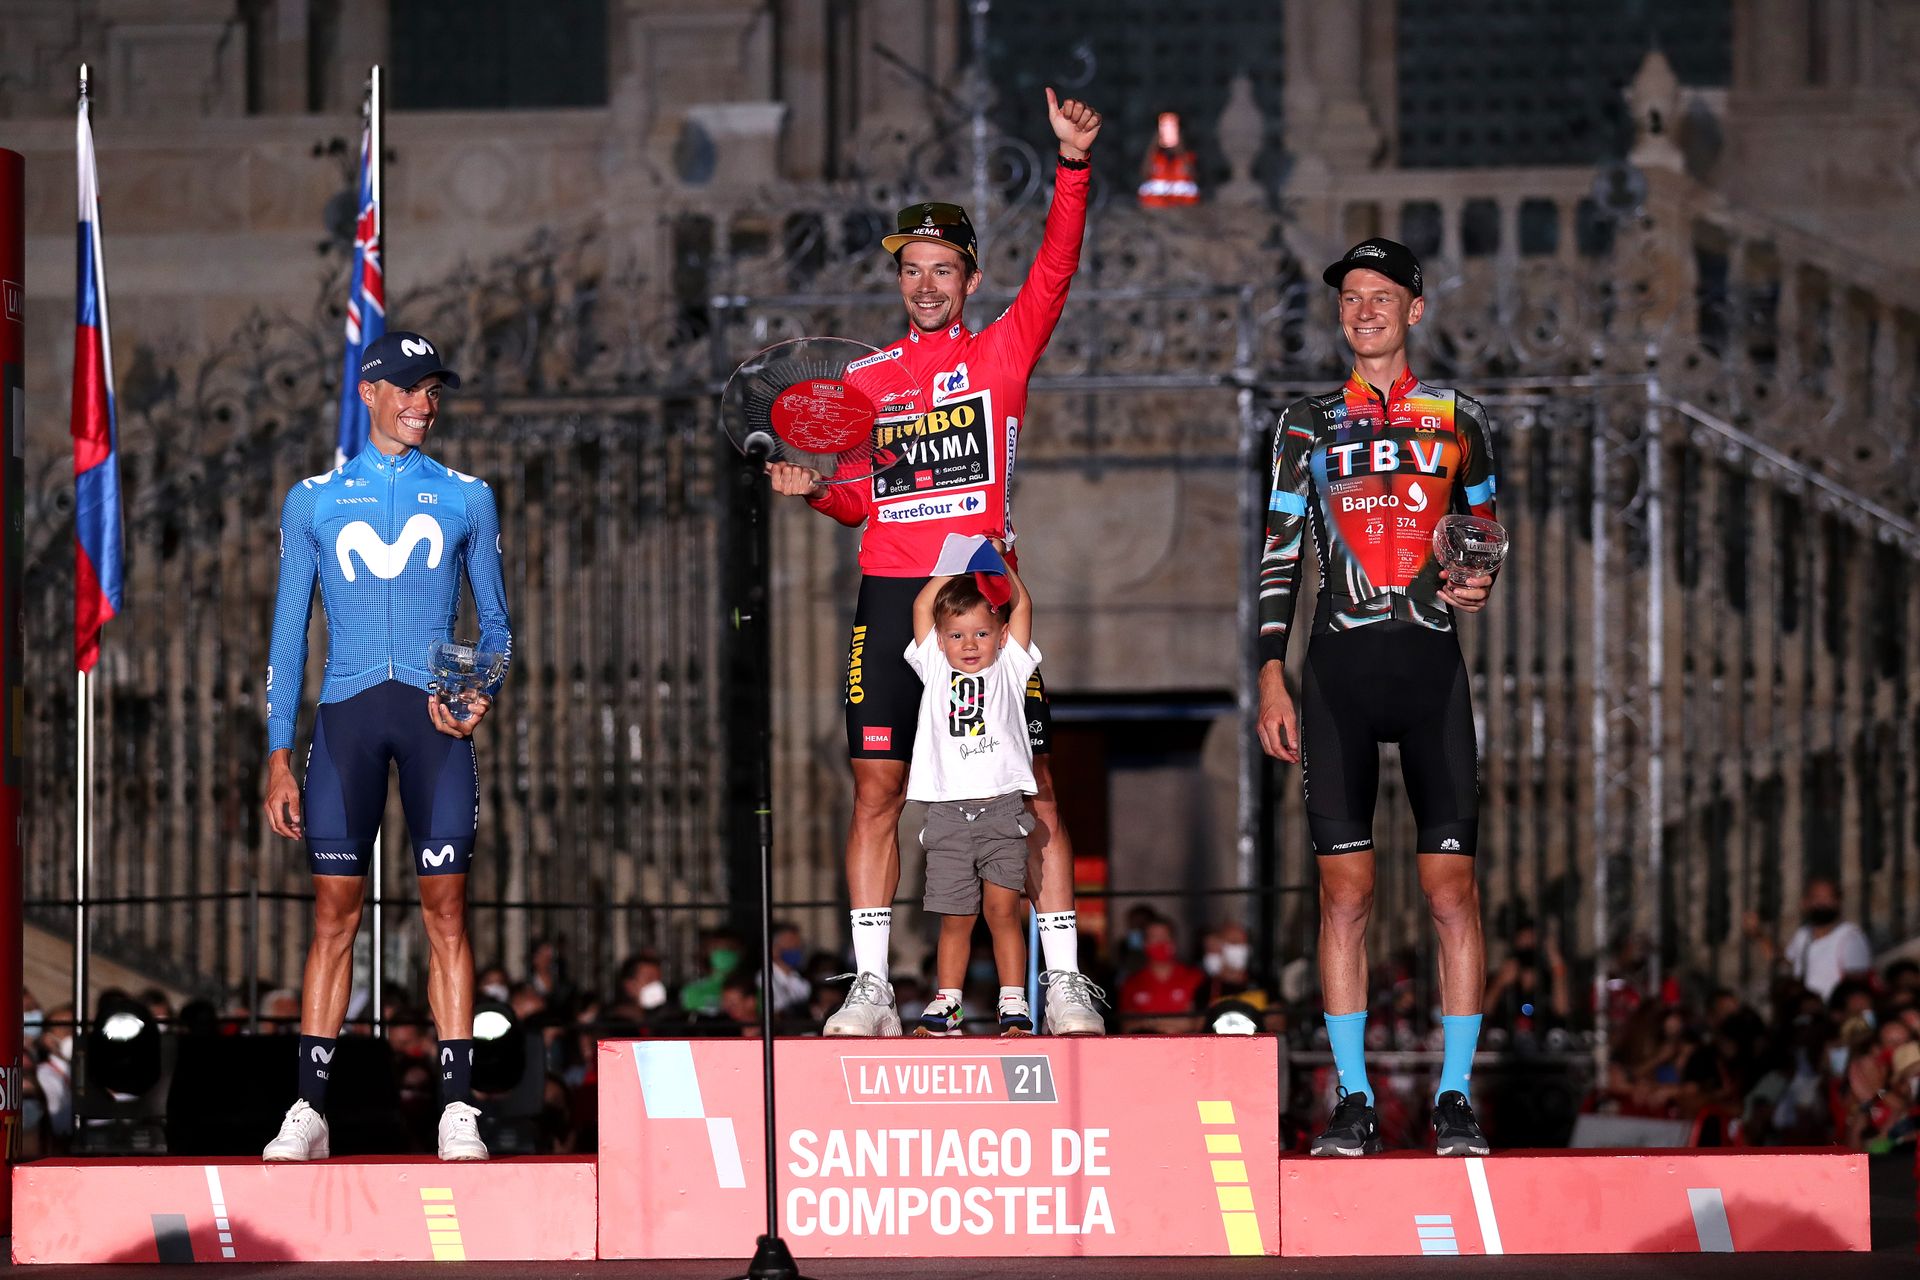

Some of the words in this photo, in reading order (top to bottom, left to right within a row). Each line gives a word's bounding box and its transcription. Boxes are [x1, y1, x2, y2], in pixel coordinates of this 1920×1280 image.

[913, 228, 940, 237] HEMA
[850, 353, 887, 370] Carrefour
[1392, 402, 1411, 412] 2.8
[1323, 408, 1347, 420] 10%
[901, 432, 980, 465] VISMA
[890, 484, 911, 493] Better
[336, 495, 378, 504] CANYON
[1342, 494, 1399, 513] Bapco
[883, 503, 953, 519] Carrefour
[1396, 517, 1417, 528] 374
[1365, 524, 1384, 534] 4.2
[849, 625, 867, 704] JUMBO
[1332, 839, 1371, 850] MERIDA
[314, 852, 357, 860] CANYON
[860, 1065, 890, 1094] LA
[895, 1065, 993, 1094] VUELTA
[1014, 1064, 1042, 1094] 21
[788, 1128, 1032, 1178] SANTIAGO
[1051, 1128, 1111, 1177] DE
[786, 1186, 1116, 1236] COMPOSTELA
